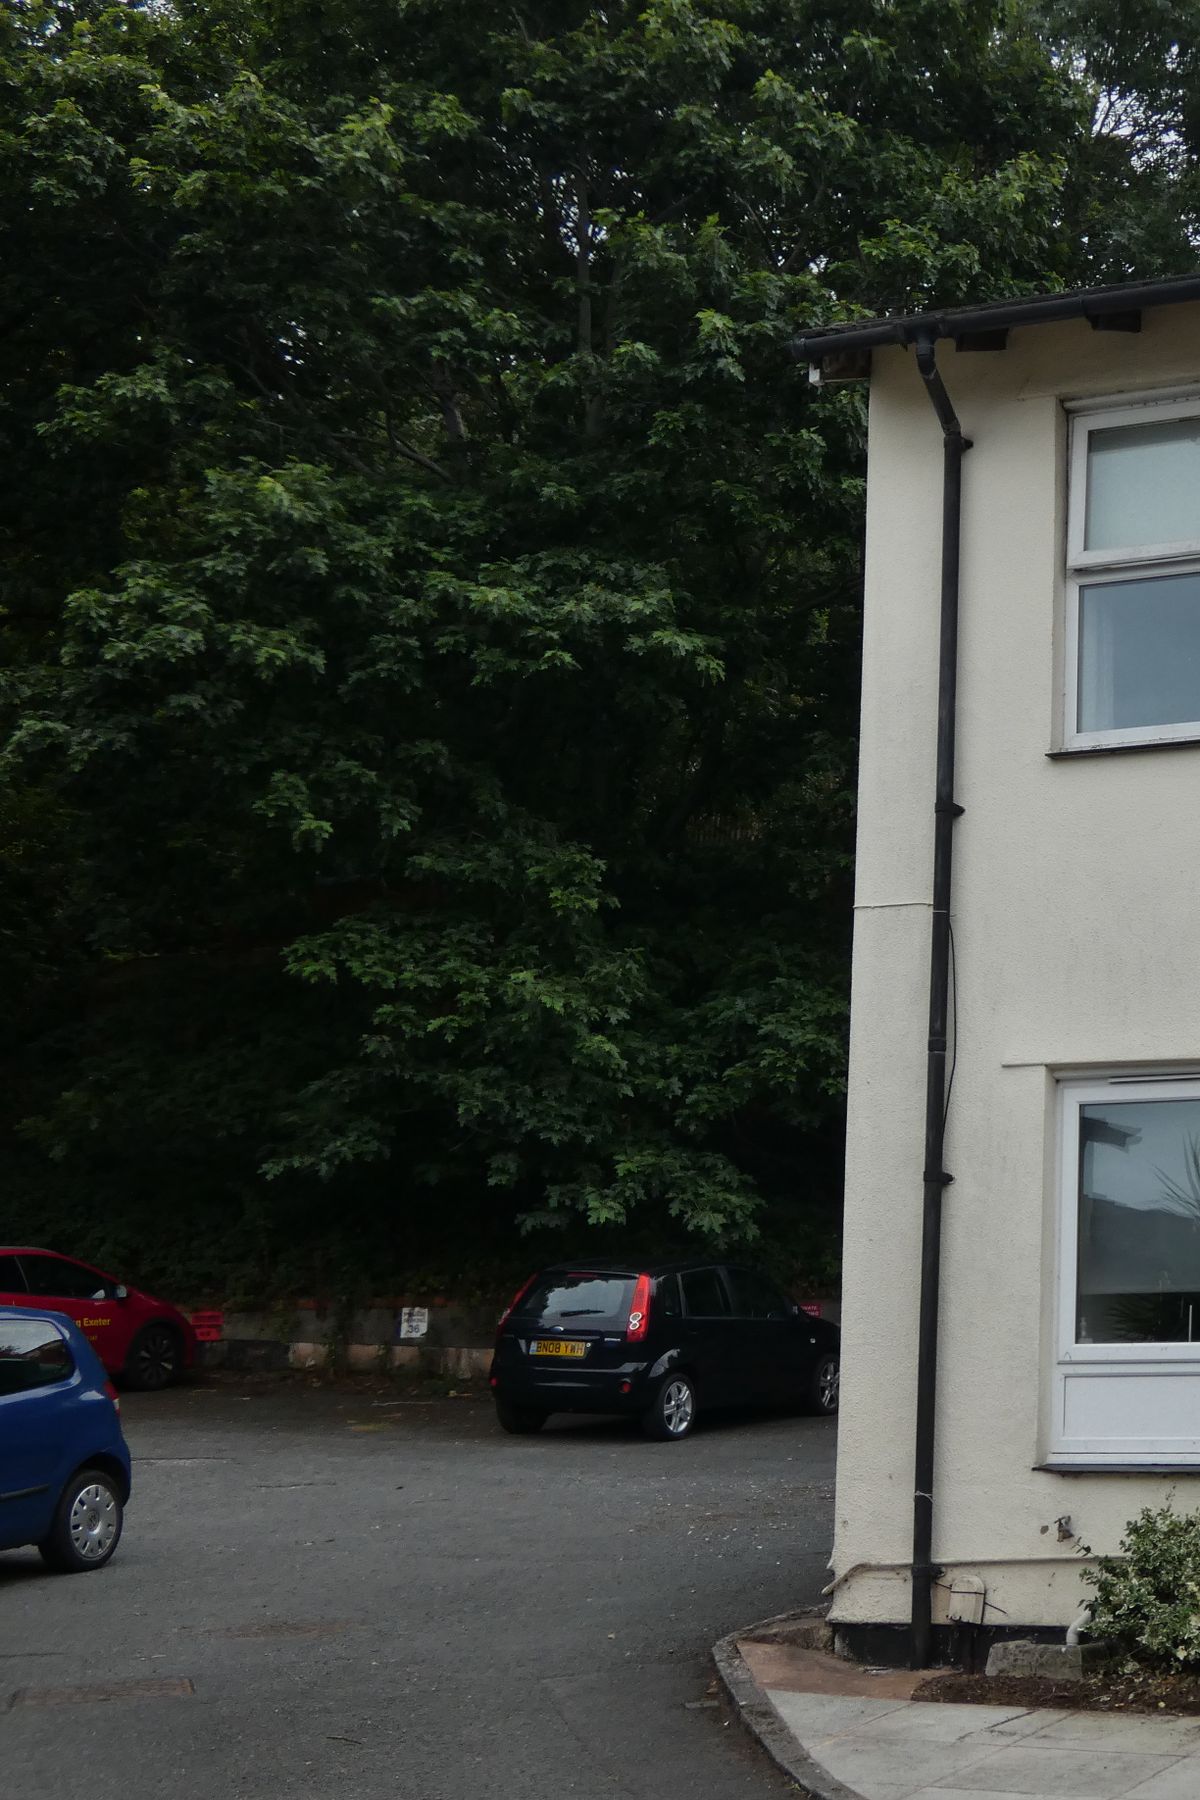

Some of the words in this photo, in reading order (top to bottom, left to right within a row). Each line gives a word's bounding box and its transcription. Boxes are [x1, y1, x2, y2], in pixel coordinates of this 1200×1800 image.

[83, 1318, 111, 1327] Exeter
[407, 1324, 420, 1333] 36
[536, 1341, 561, 1353] BN08
